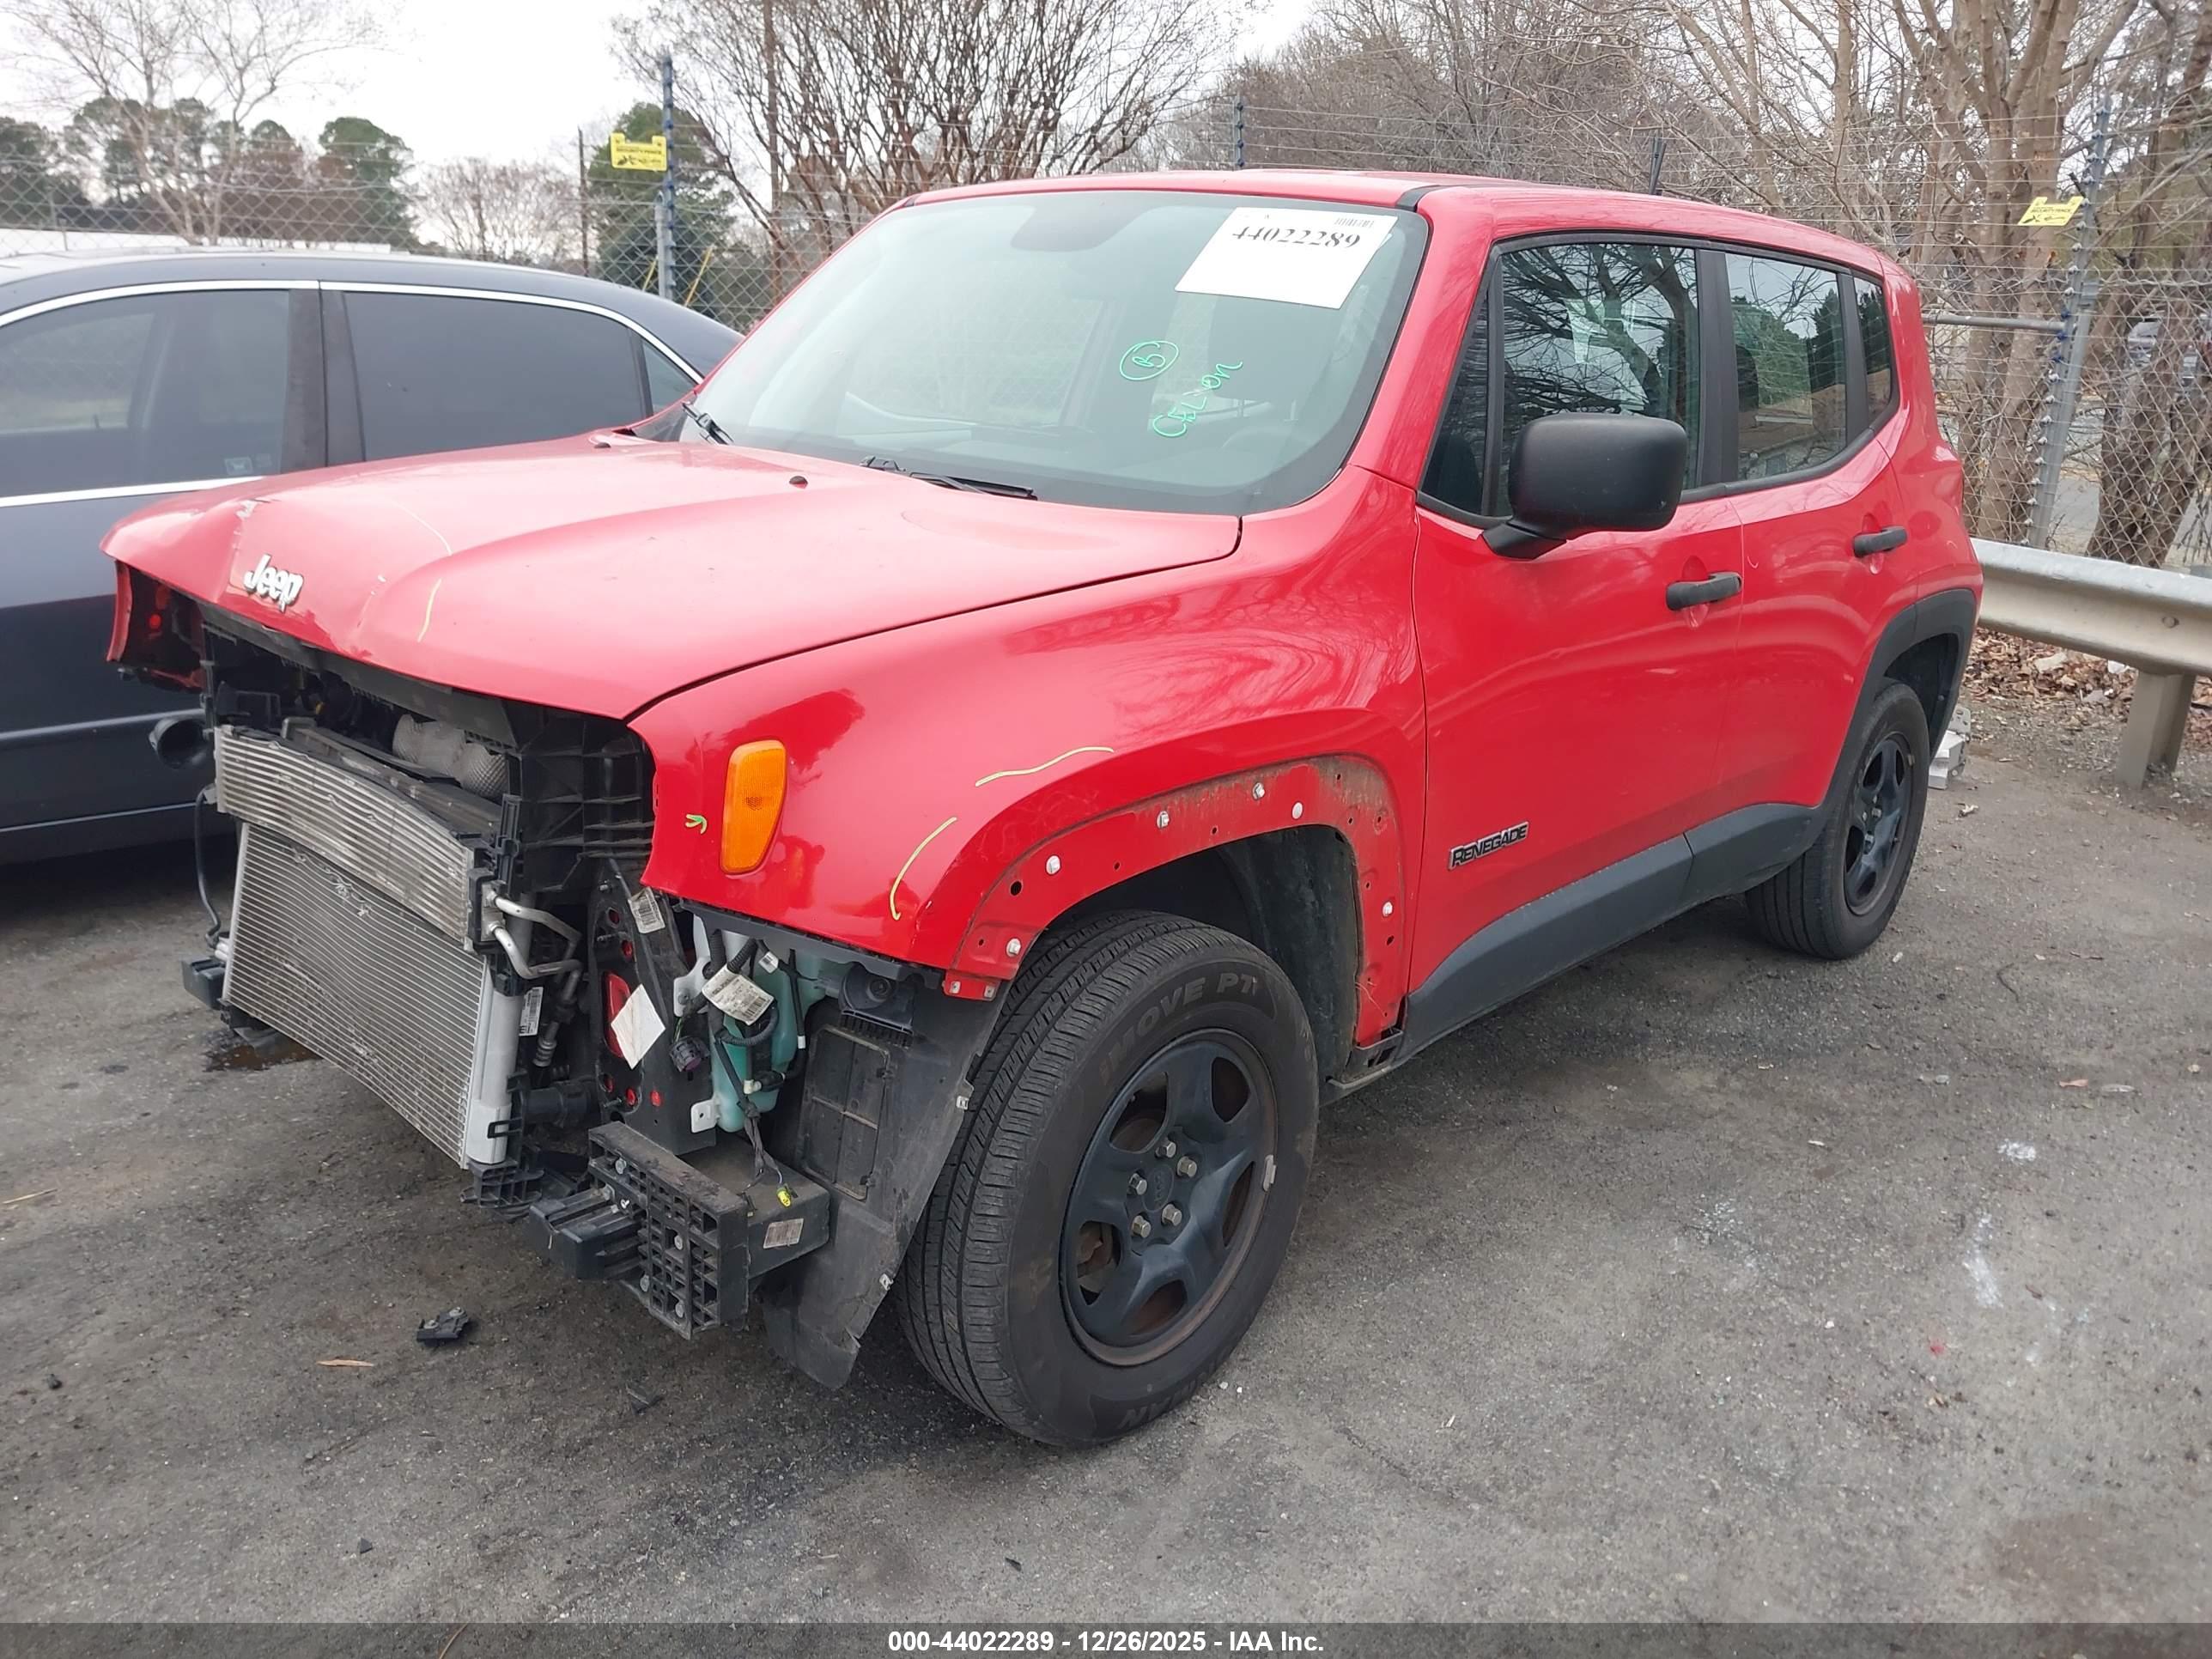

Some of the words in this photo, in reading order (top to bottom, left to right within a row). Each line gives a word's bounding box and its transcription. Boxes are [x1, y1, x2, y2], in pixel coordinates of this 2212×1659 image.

[1232, 226, 1361, 248] 44022289
[243, 553, 304, 614] Jeep
[1449, 821, 1529, 871] RENEGADE
